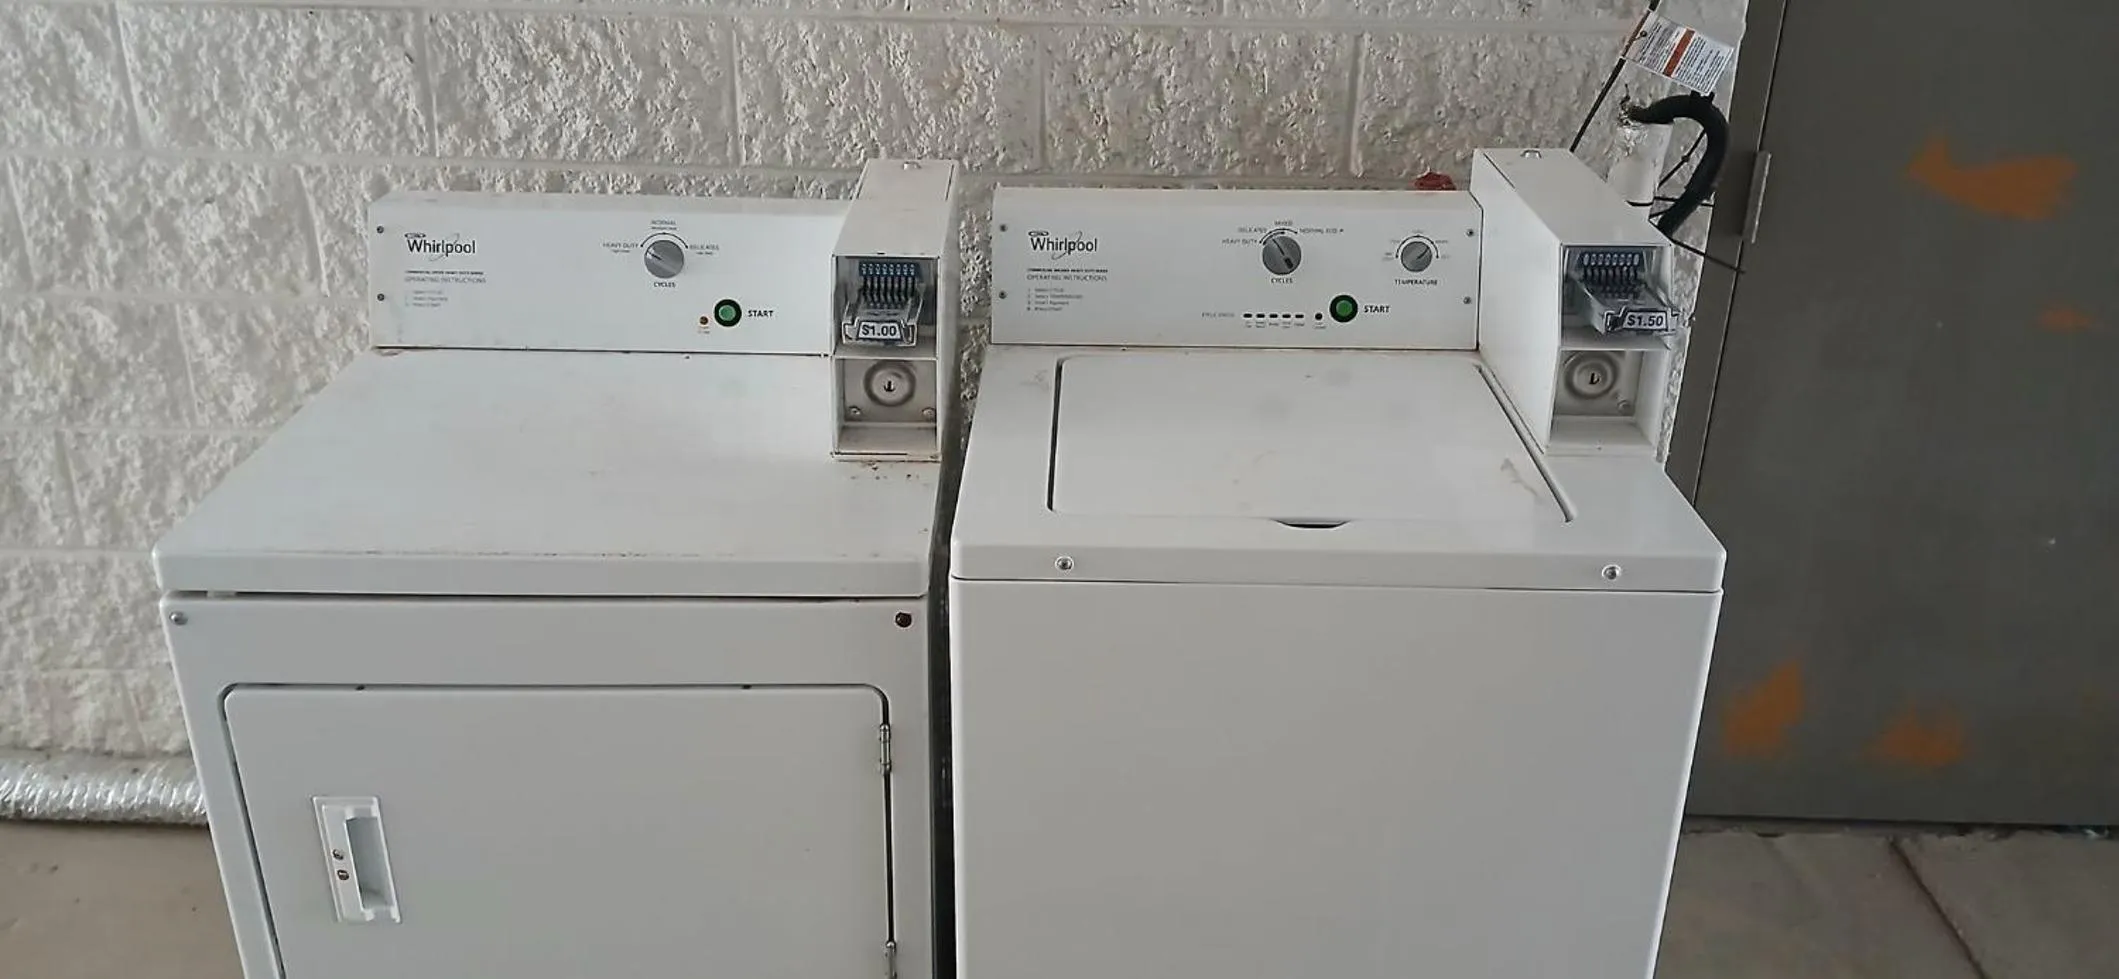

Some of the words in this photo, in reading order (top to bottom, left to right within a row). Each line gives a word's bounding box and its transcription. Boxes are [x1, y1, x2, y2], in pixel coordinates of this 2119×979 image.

[406, 239, 476, 257] Whirlpool
[1030, 237, 1097, 255] Whirlpool
[748, 309, 774, 317] START
[1363, 305, 1391, 313] START
